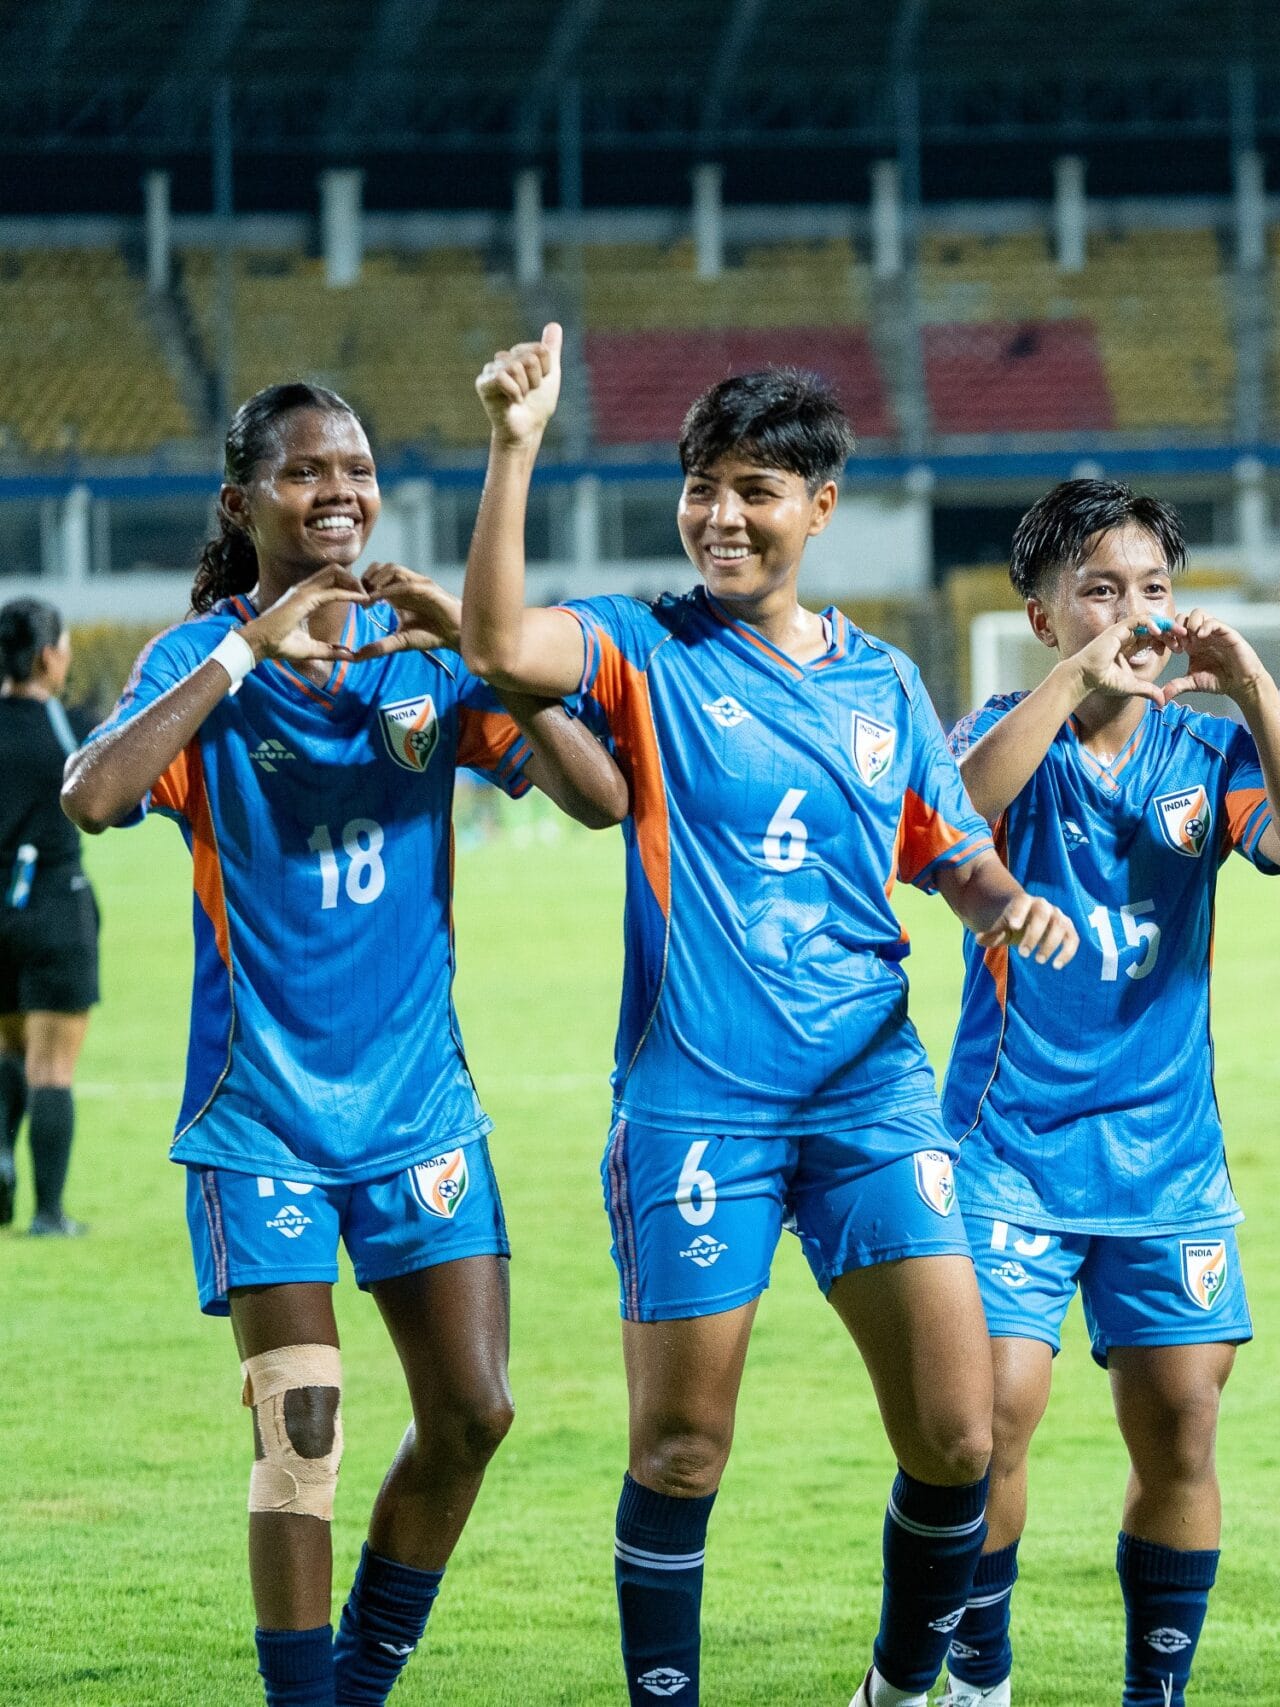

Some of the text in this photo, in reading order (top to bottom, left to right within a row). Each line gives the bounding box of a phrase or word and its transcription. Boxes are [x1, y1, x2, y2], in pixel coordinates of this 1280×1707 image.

[388, 709, 418, 722] INDIA
[249, 751, 297, 760] NIVIA
[1164, 798, 1192, 812] INDIA
[762, 788, 809, 873] 6
[307, 818, 386, 910] 18
[1088, 899, 1162, 982] 15
[417, 1157, 447, 1170] INDIA
[675, 1140, 717, 1226] 6
[266, 1216, 313, 1228] NIVIA
[679, 1243, 728, 1258] NIVIA
[1188, 1249, 1213, 1257] INDIA
